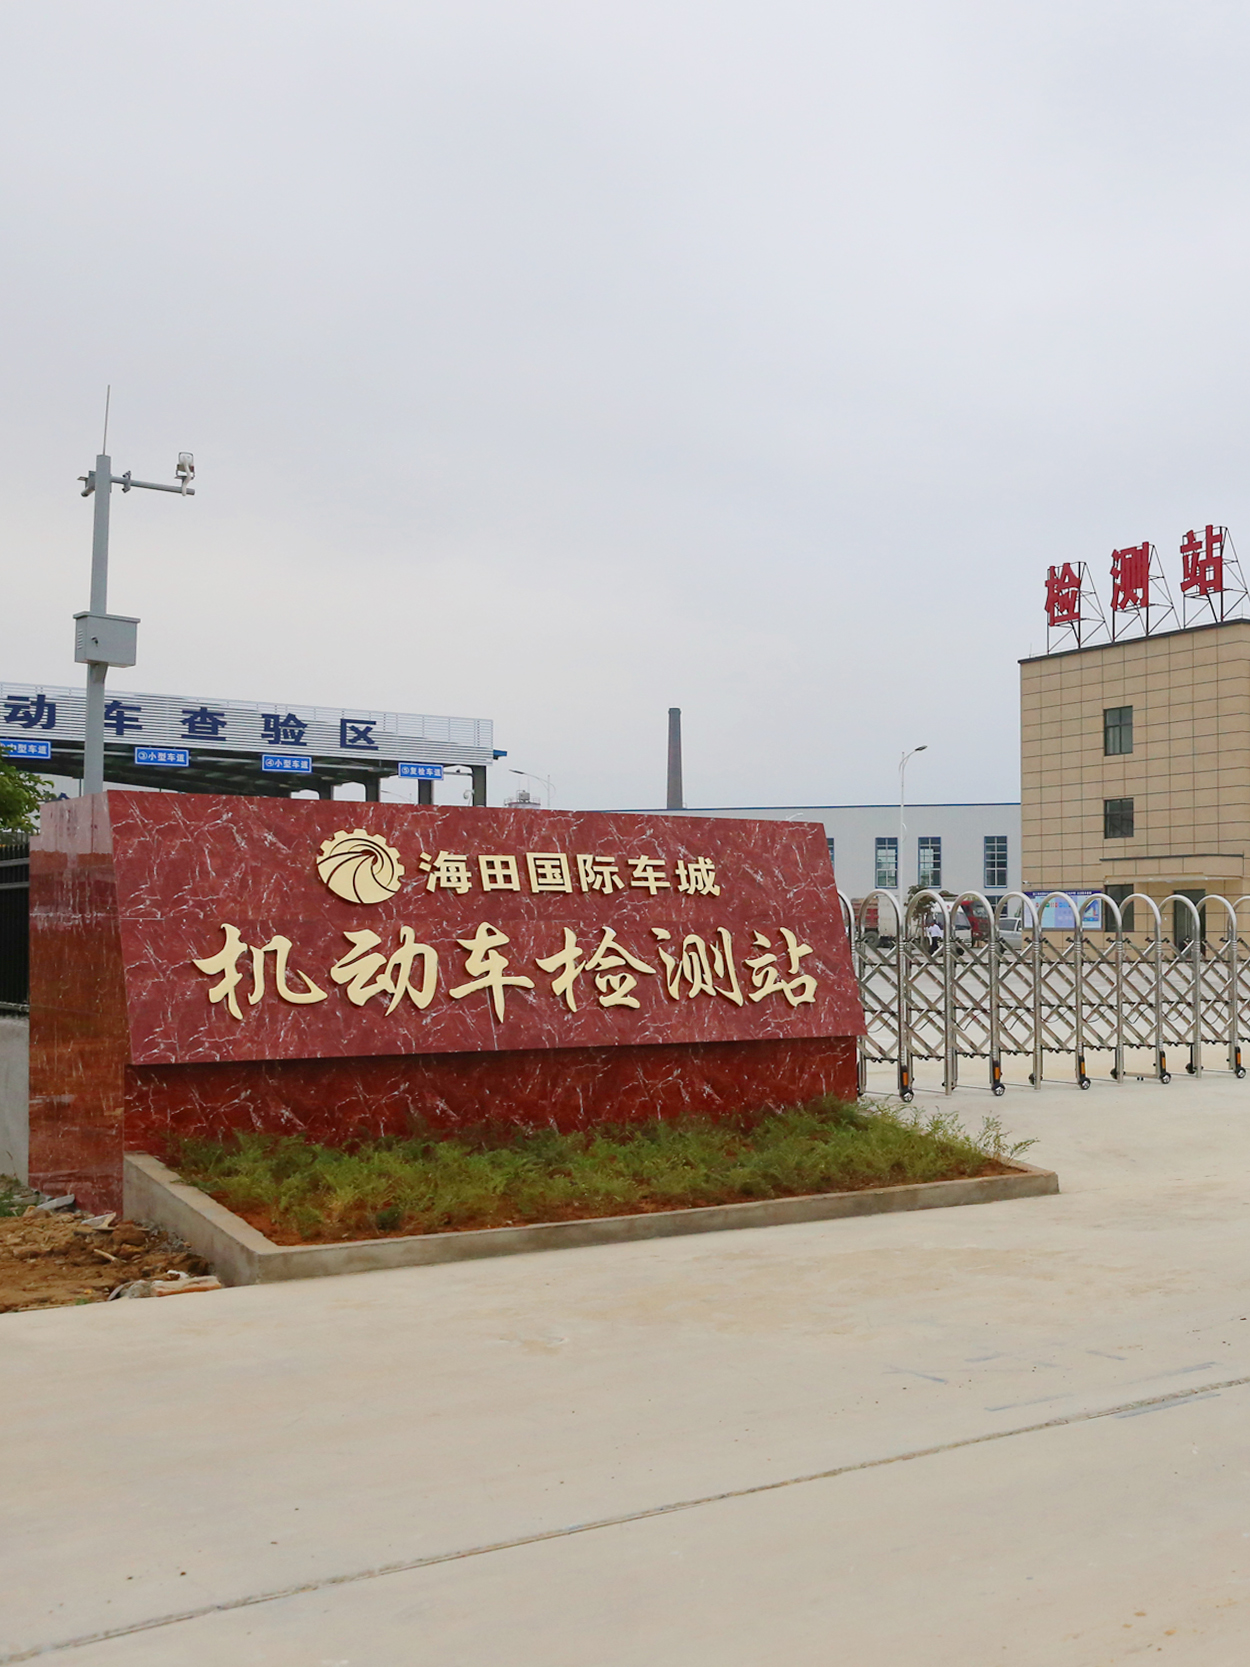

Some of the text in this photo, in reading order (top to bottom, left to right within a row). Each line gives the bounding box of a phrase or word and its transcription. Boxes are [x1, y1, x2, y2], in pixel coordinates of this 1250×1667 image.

[1044, 524, 1223, 627] 检测站
[3, 694, 379, 751] 动车查验区
[419, 850, 722, 898] 海田国际车城
[193, 922, 818, 1024] 机动车检测站
